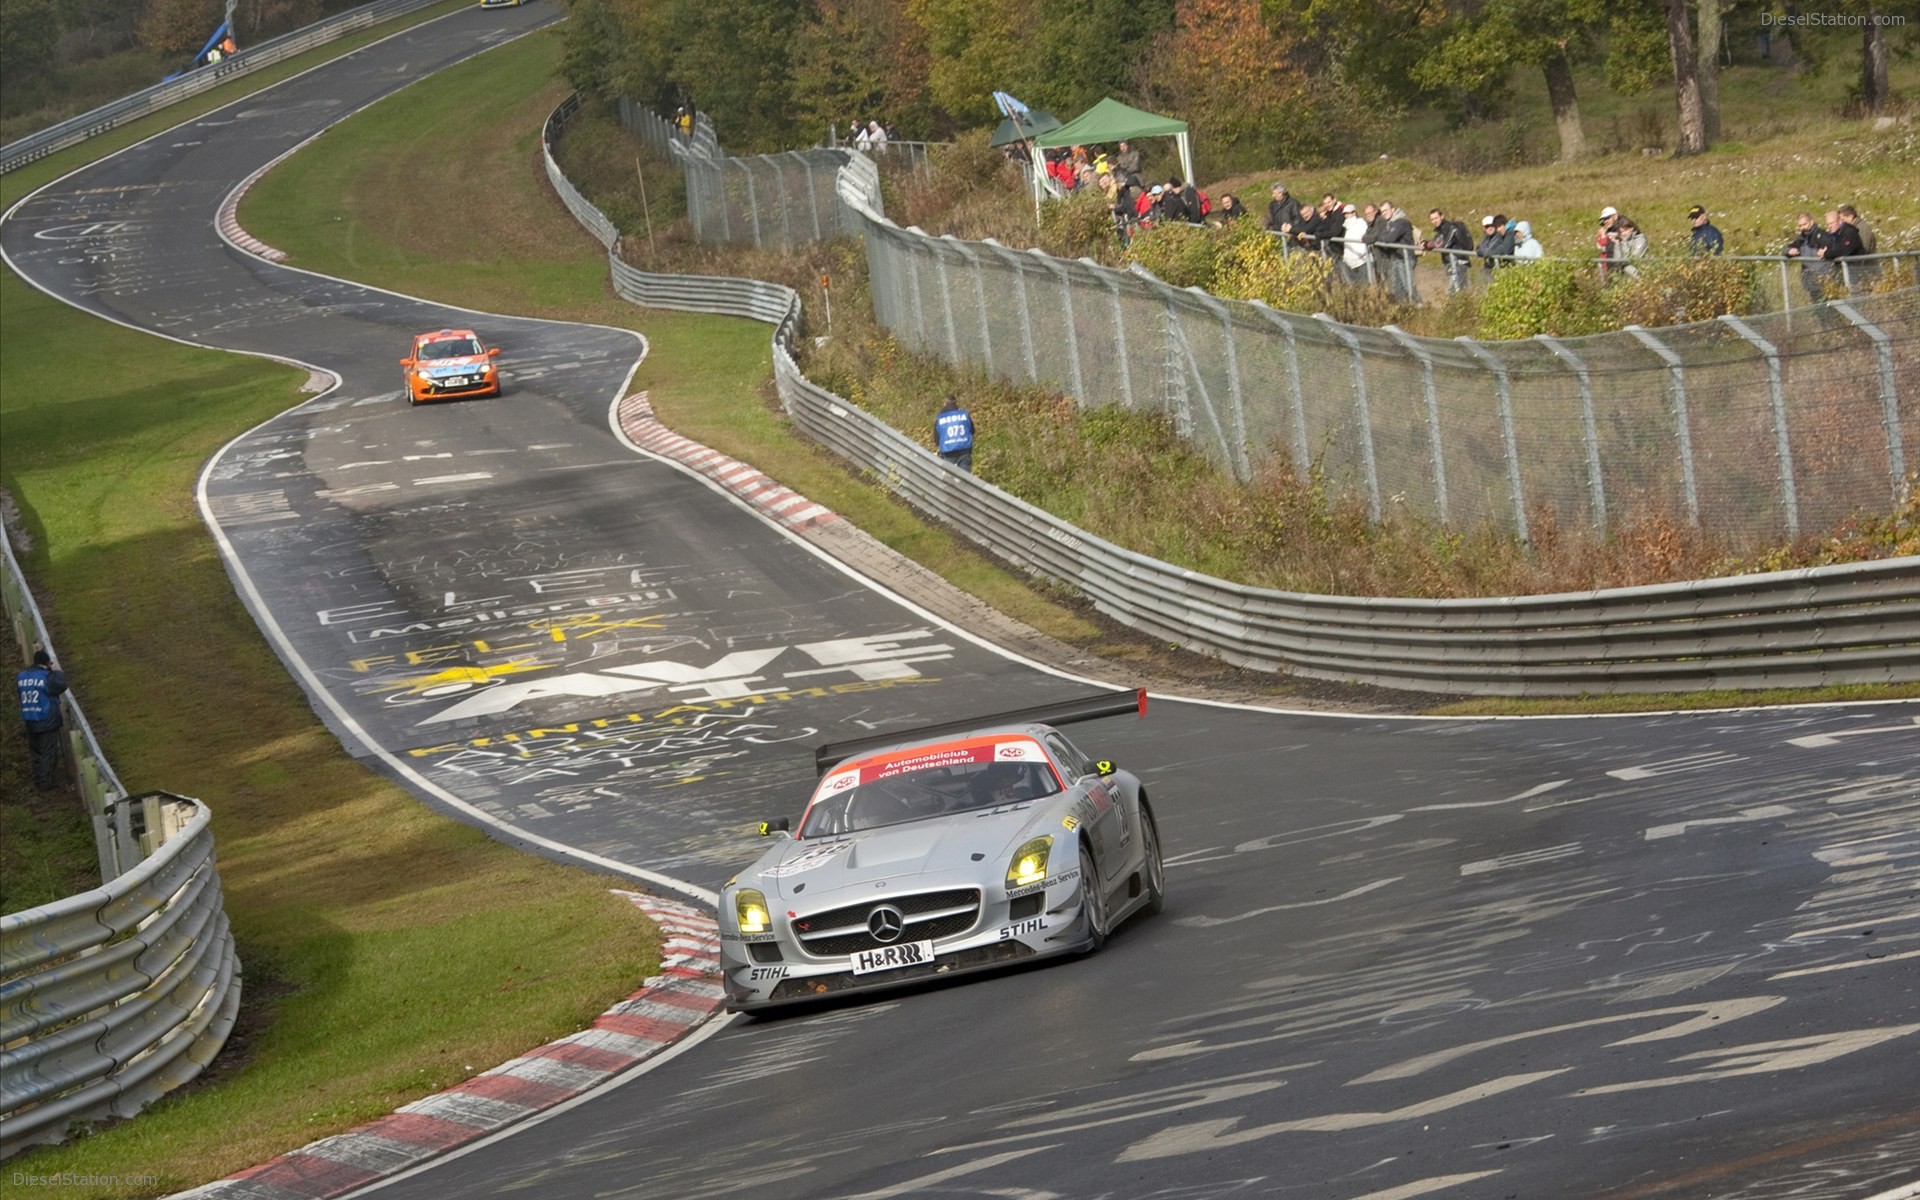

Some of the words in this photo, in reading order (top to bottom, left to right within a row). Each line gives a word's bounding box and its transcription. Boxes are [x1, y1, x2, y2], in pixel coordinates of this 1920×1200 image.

[938, 414, 967, 426] MEDIA
[947, 424, 965, 438] 073
[349, 613, 667, 672] FELIX
[18, 678, 45, 688] MEDIA
[21, 690, 39, 704] 032
[878, 768, 899, 779] von
[902, 756, 975, 773] Deutschland
[884, 749, 969, 770] Automobilclub
[1006, 878, 1058, 899] Mercedes-Benz
[1057, 870, 1080, 883] Service
[1000, 918, 1049, 940] STIHL
[750, 966, 790, 981] STIHL
